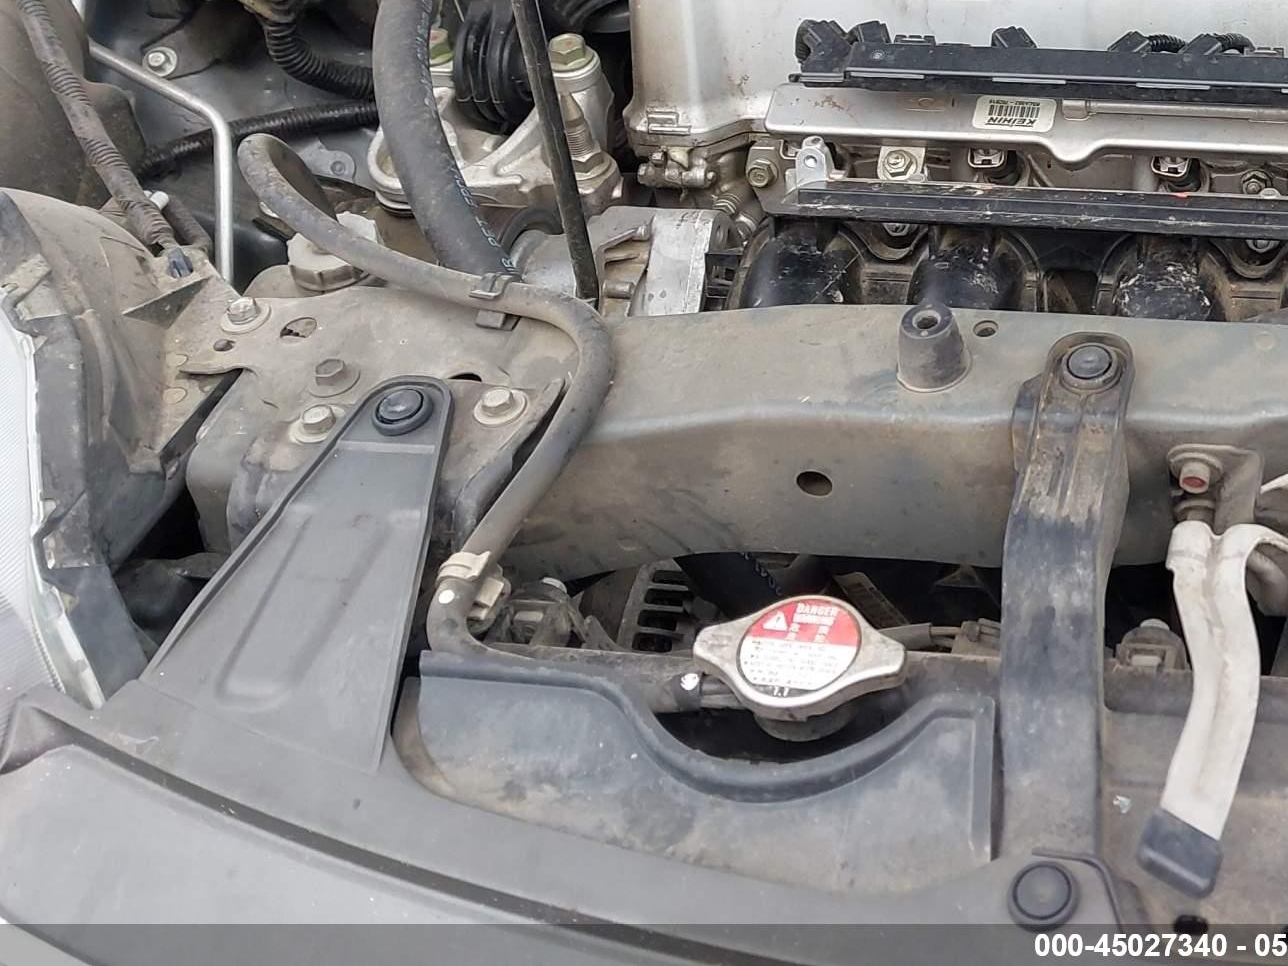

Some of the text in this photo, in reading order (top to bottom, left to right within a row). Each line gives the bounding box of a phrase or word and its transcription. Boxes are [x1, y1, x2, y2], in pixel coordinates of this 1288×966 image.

[987, 117, 1037, 126] KEIHIN
[795, 602, 840, 618] DANGER
[773, 686, 790, 699] 1.1
